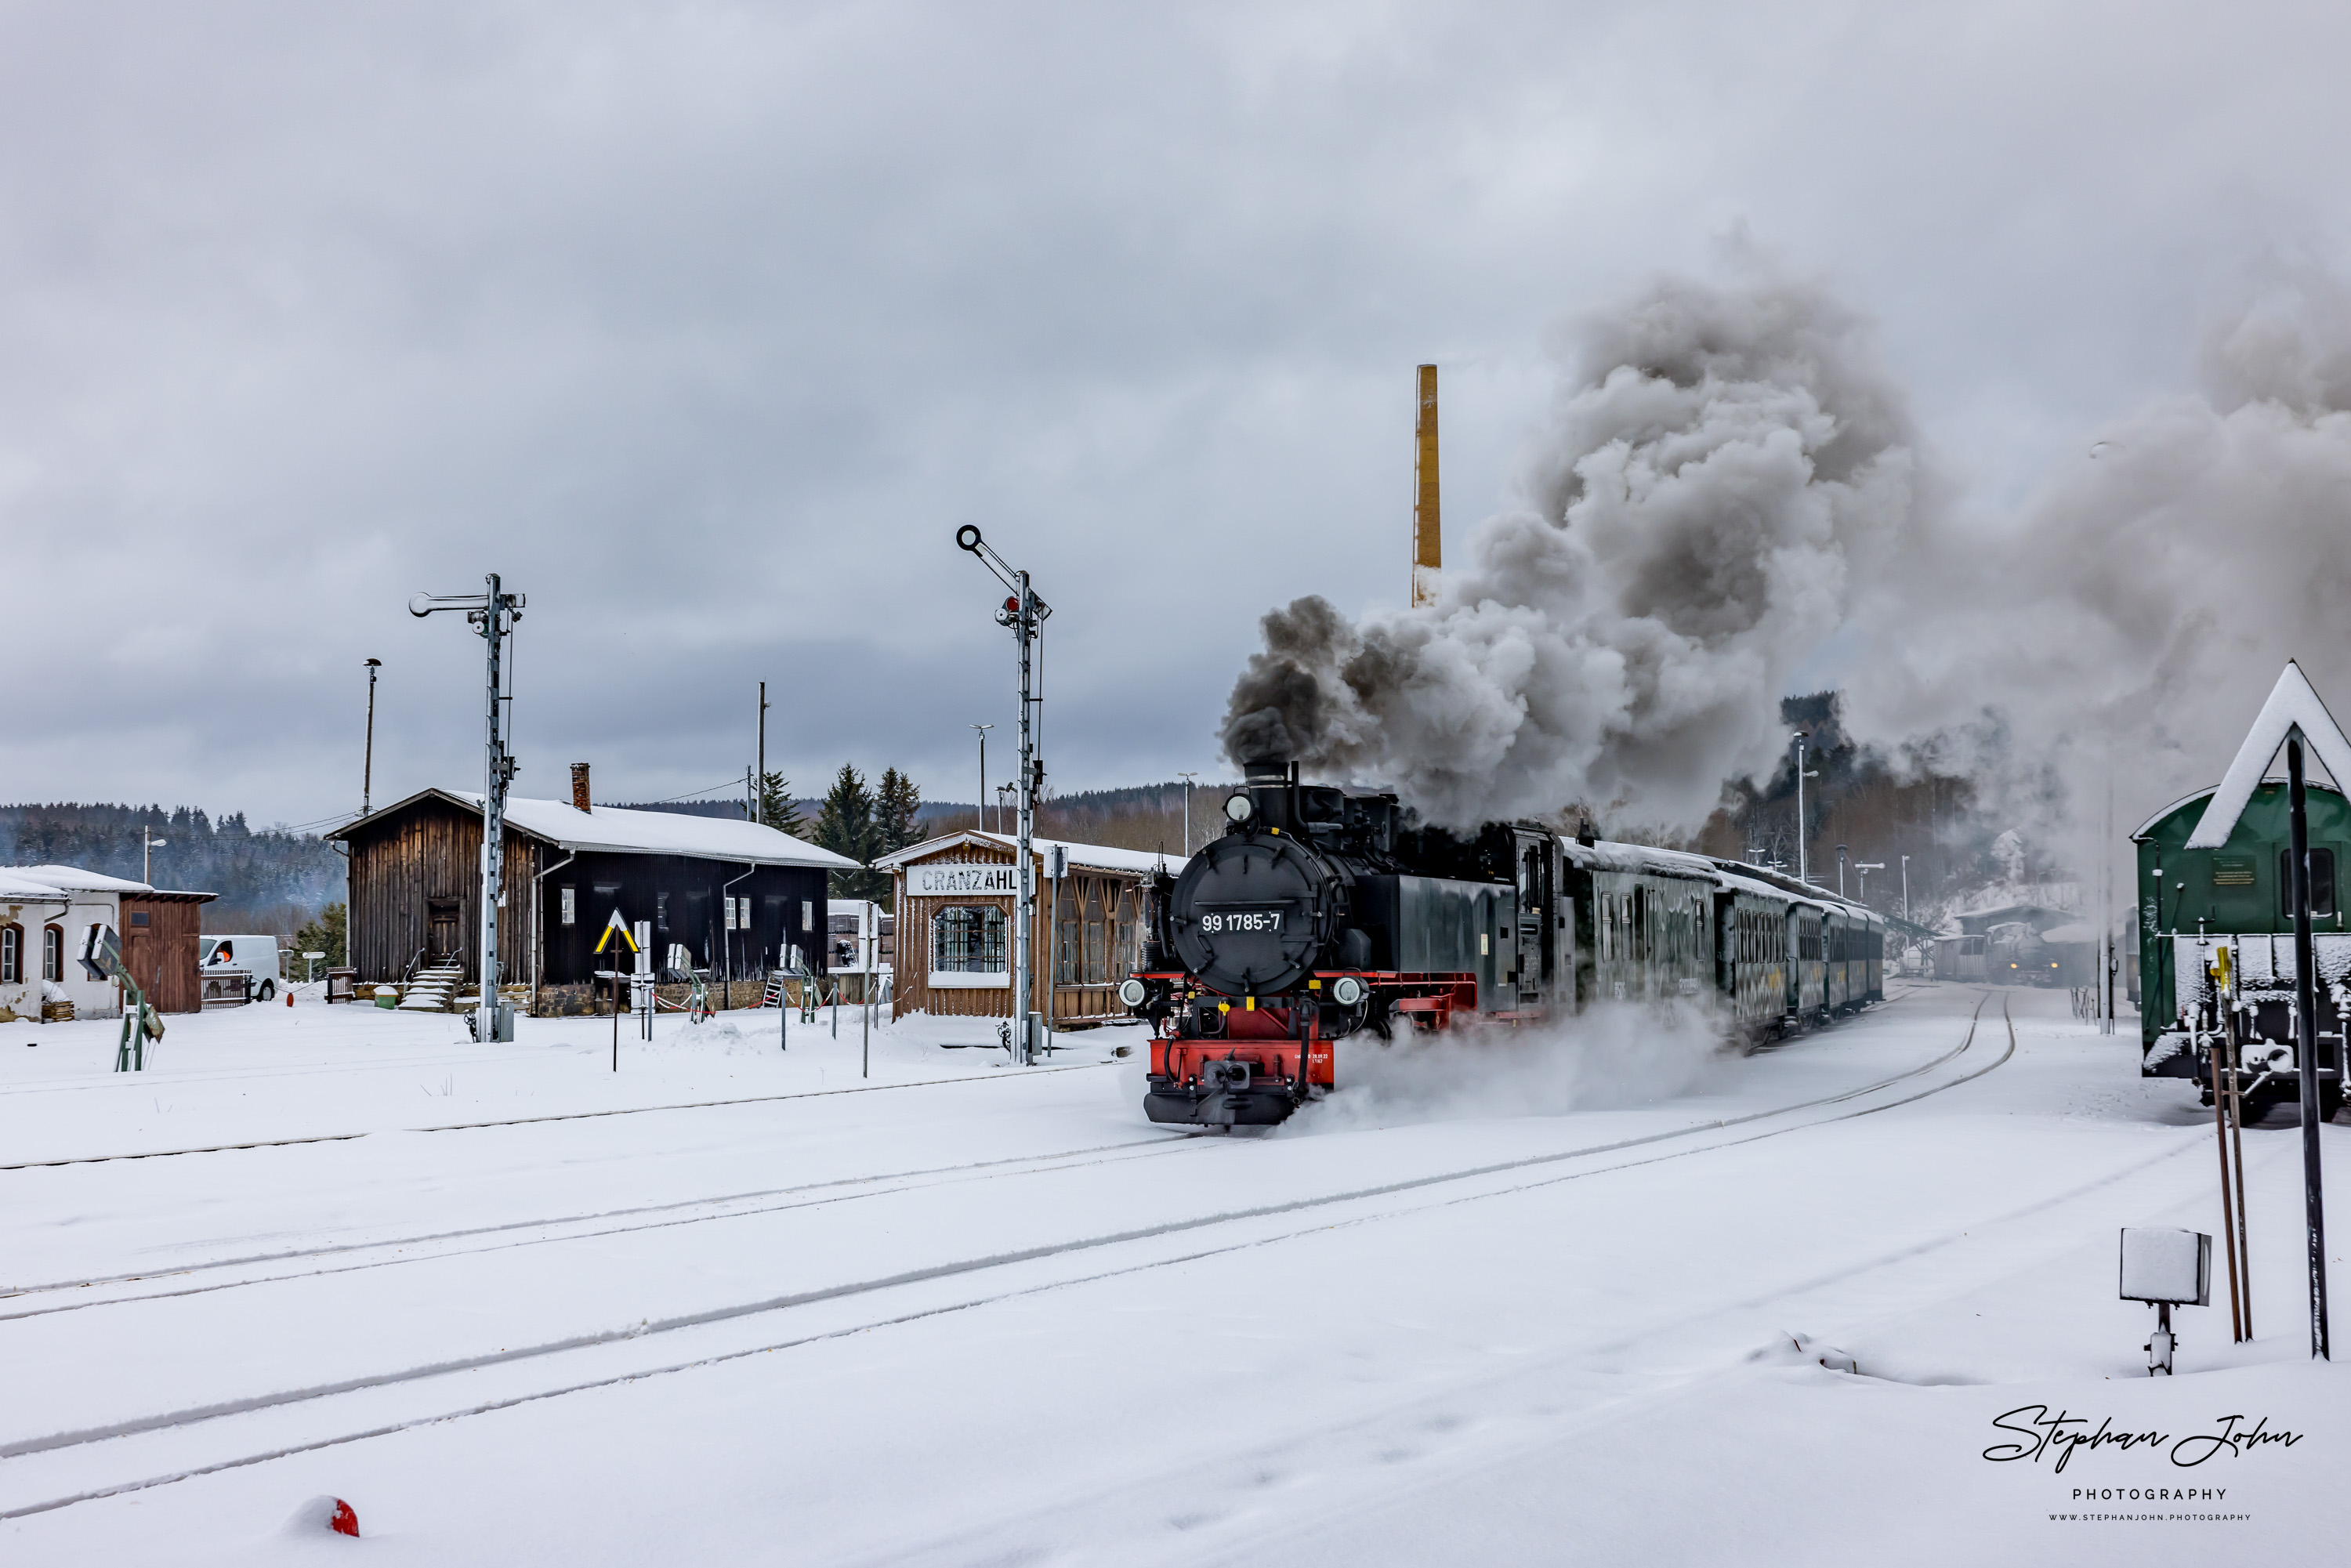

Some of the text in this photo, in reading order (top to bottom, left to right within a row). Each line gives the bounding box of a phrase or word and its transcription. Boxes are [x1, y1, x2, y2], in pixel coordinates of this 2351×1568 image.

[922, 870, 1017, 890] CRANZAHL
[1202, 913, 1281, 932] 99 1785-7
